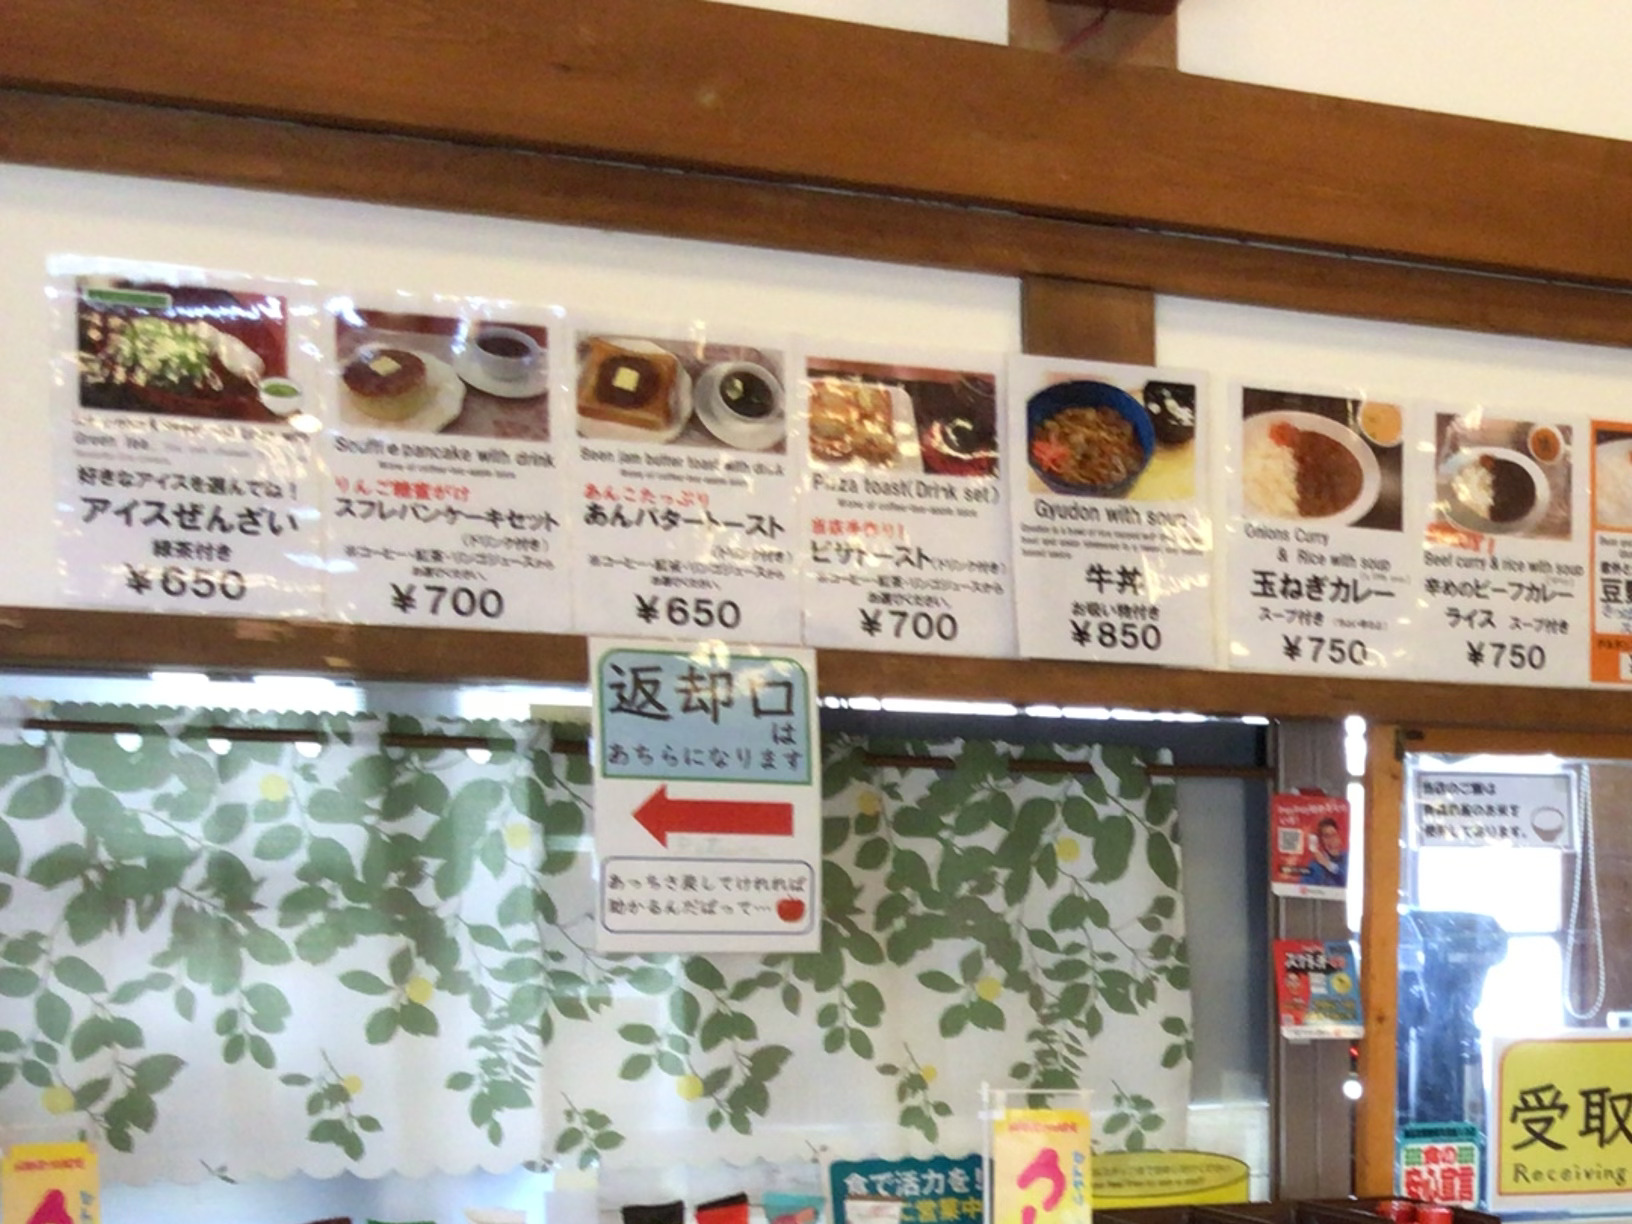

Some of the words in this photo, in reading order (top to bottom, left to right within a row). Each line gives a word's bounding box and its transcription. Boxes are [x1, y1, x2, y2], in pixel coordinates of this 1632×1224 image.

[477, 449, 511, 465] with
[516, 451, 556, 468] drink
[81, 497, 300, 536] アイスぜんざい
[1035, 499, 1100, 523] Gyudon
[1105, 504, 1142, 524] with
[152, 539, 232, 562] 緑茶付き
[1297, 549, 1326, 566] Rice
[125, 562, 246, 600] ¥650
[1085, 563, 1144, 595] 牛丼
[1251, 569, 1395, 604] 玉ねぎカレー
[390, 583, 504, 618] ¥700
[633, 593, 742, 629] ¥650
[858, 608, 959, 641] ¥700
[1258, 607, 1325, 627] スープ付き
[1445, 607, 1497, 630] ライス
[1070, 619, 1162, 651] ¥850
[1281, 634, 1368, 666] ¥750
[1466, 640, 1546, 670] ¥750
[608, 663, 795, 724] 返却口
[1513, 1162, 1628, 1186] Receiving
